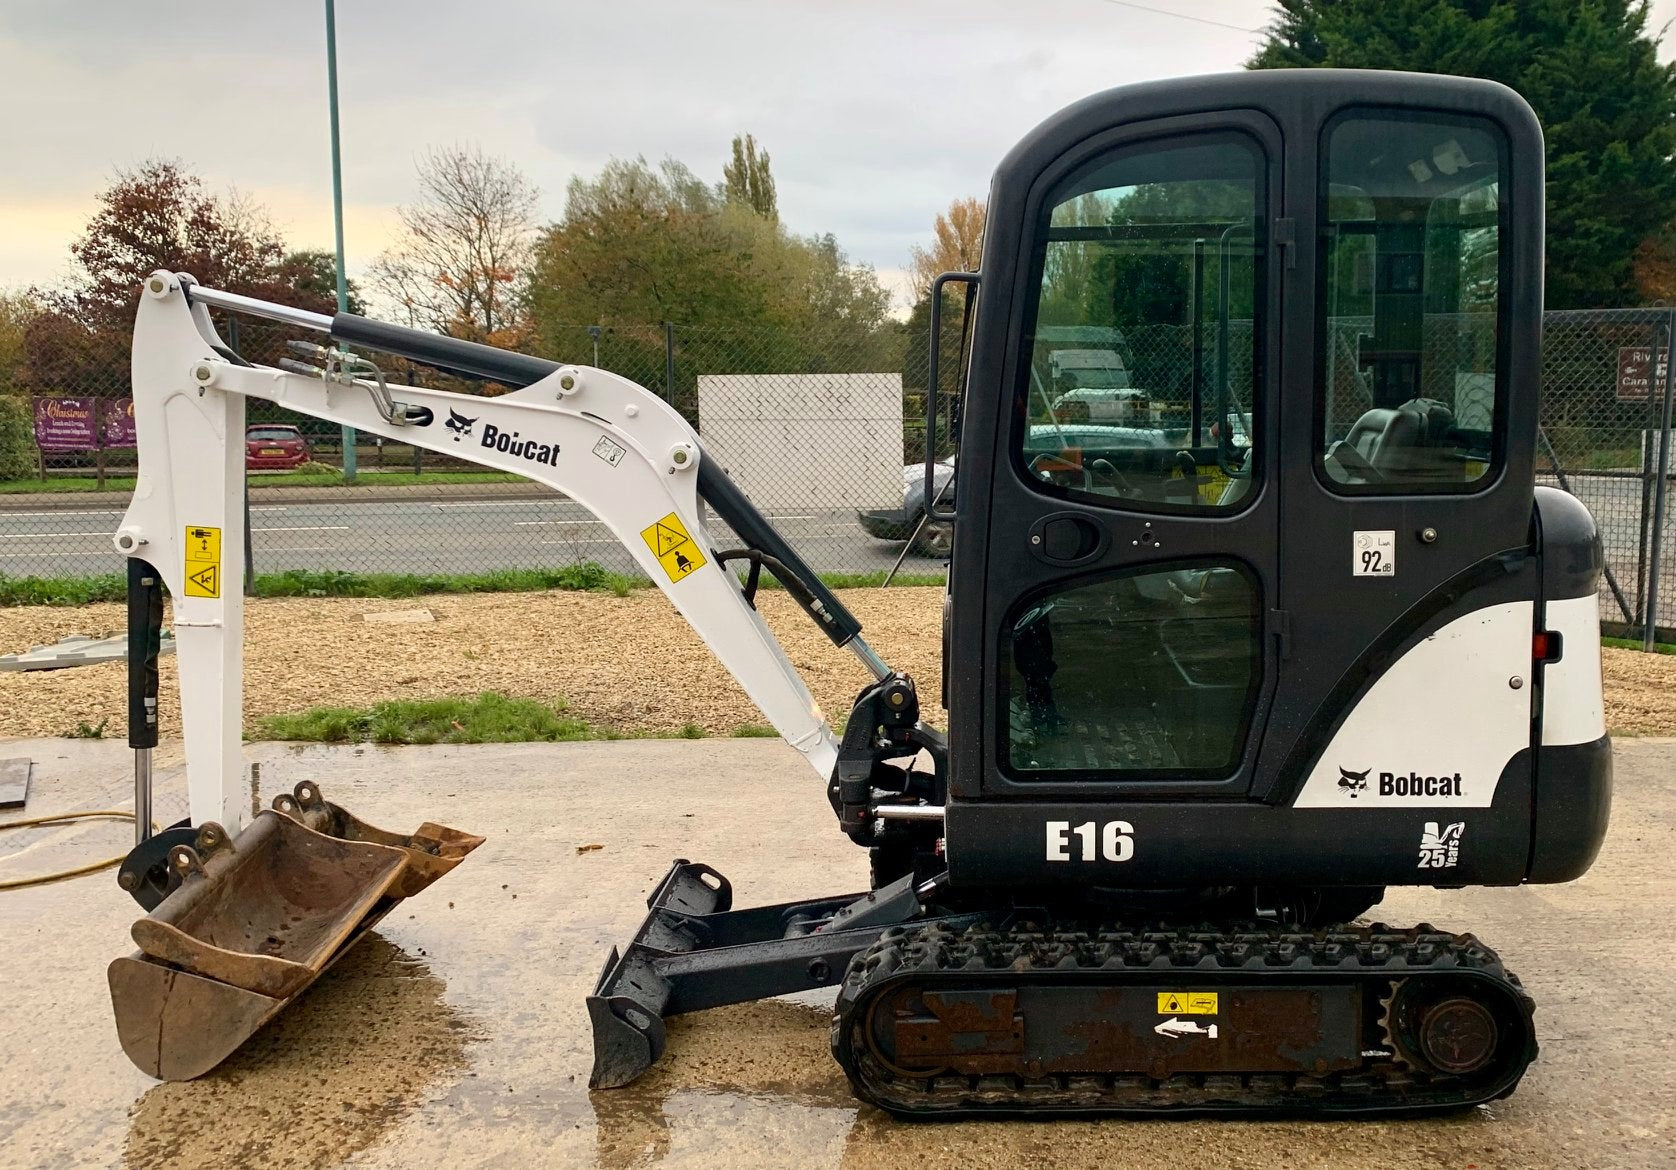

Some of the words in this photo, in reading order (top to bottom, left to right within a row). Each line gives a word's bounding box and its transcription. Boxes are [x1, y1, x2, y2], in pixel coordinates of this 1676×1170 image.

[481, 423, 561, 467] Bobcat
[1361, 550, 1382, 573] 92
[1379, 772, 1462, 796] Bobcat
[1046, 820, 1135, 862] E16
[1417, 849, 1446, 868] 25
